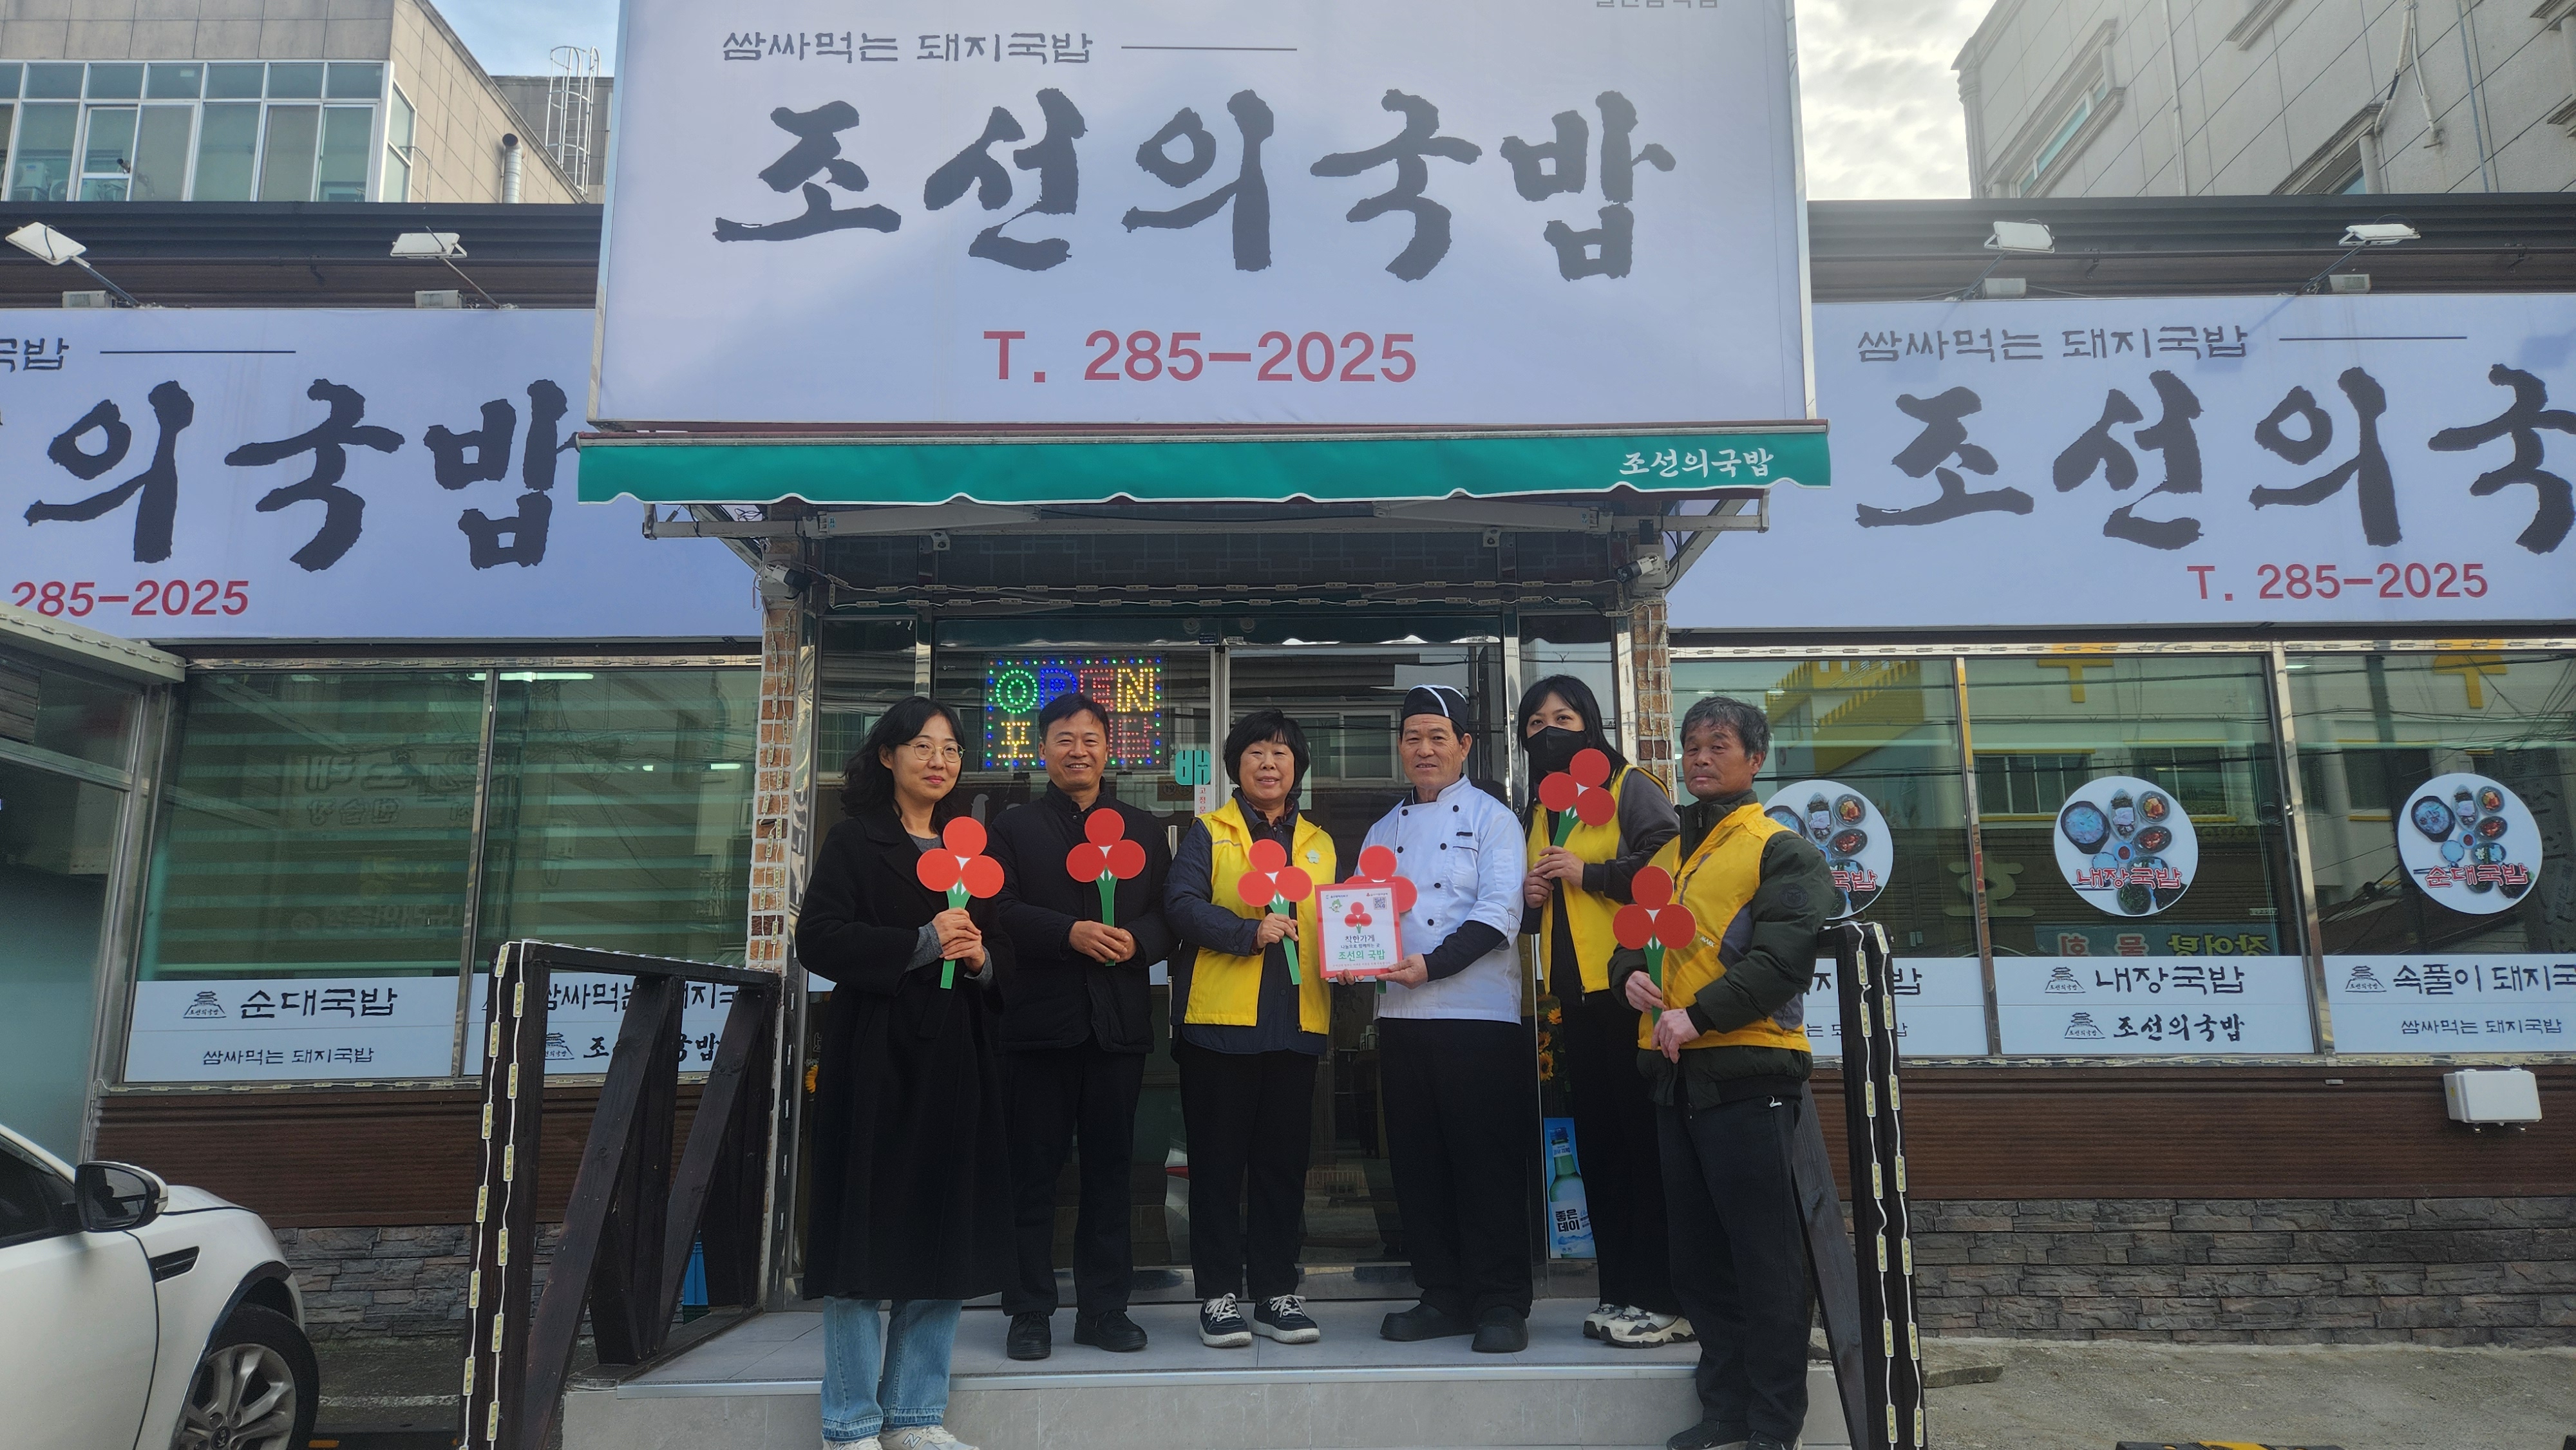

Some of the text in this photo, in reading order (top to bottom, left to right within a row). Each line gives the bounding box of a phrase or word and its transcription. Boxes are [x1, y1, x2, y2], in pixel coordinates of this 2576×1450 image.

[723, 31, 1094, 65] 쌈싸먹는 돼지국밥
[712, 88, 1676, 282] 조선의국밥
[1084, 330, 1416, 383] 285-2025
[1857, 325, 2249, 363] 쌈싸먹는 돼지국밥
[1619, 448, 1774, 478] 조선의국밥
[2257, 562, 2489, 601] 285-2025
[11, 579, 250, 617] 285-2025
[995, 668, 1154, 715] OPEN
[2076, 867, 2183, 889] 내장국밥
[2425, 863, 2530, 889] 순대국밥
[1345, 934, 1375, 944] 착한가게
[1338, 949, 1385, 961] 조선의 국밥
[2094, 965, 2246, 995] 내장국밥
[2393, 963, 2482, 995] 속풀이
[240, 986, 398, 1019] 순대국밥
[2114, 1012, 2246, 1042] 조선의국밥
[2400, 1019, 2562, 1035] 쌈싸먹는 돼지국밥
[203, 1047, 375, 1066] 쌈싸먹는 돼지국밥
[1555, 1209, 1578, 1222] 좋은
[1557, 1219, 1580, 1232] 데이
